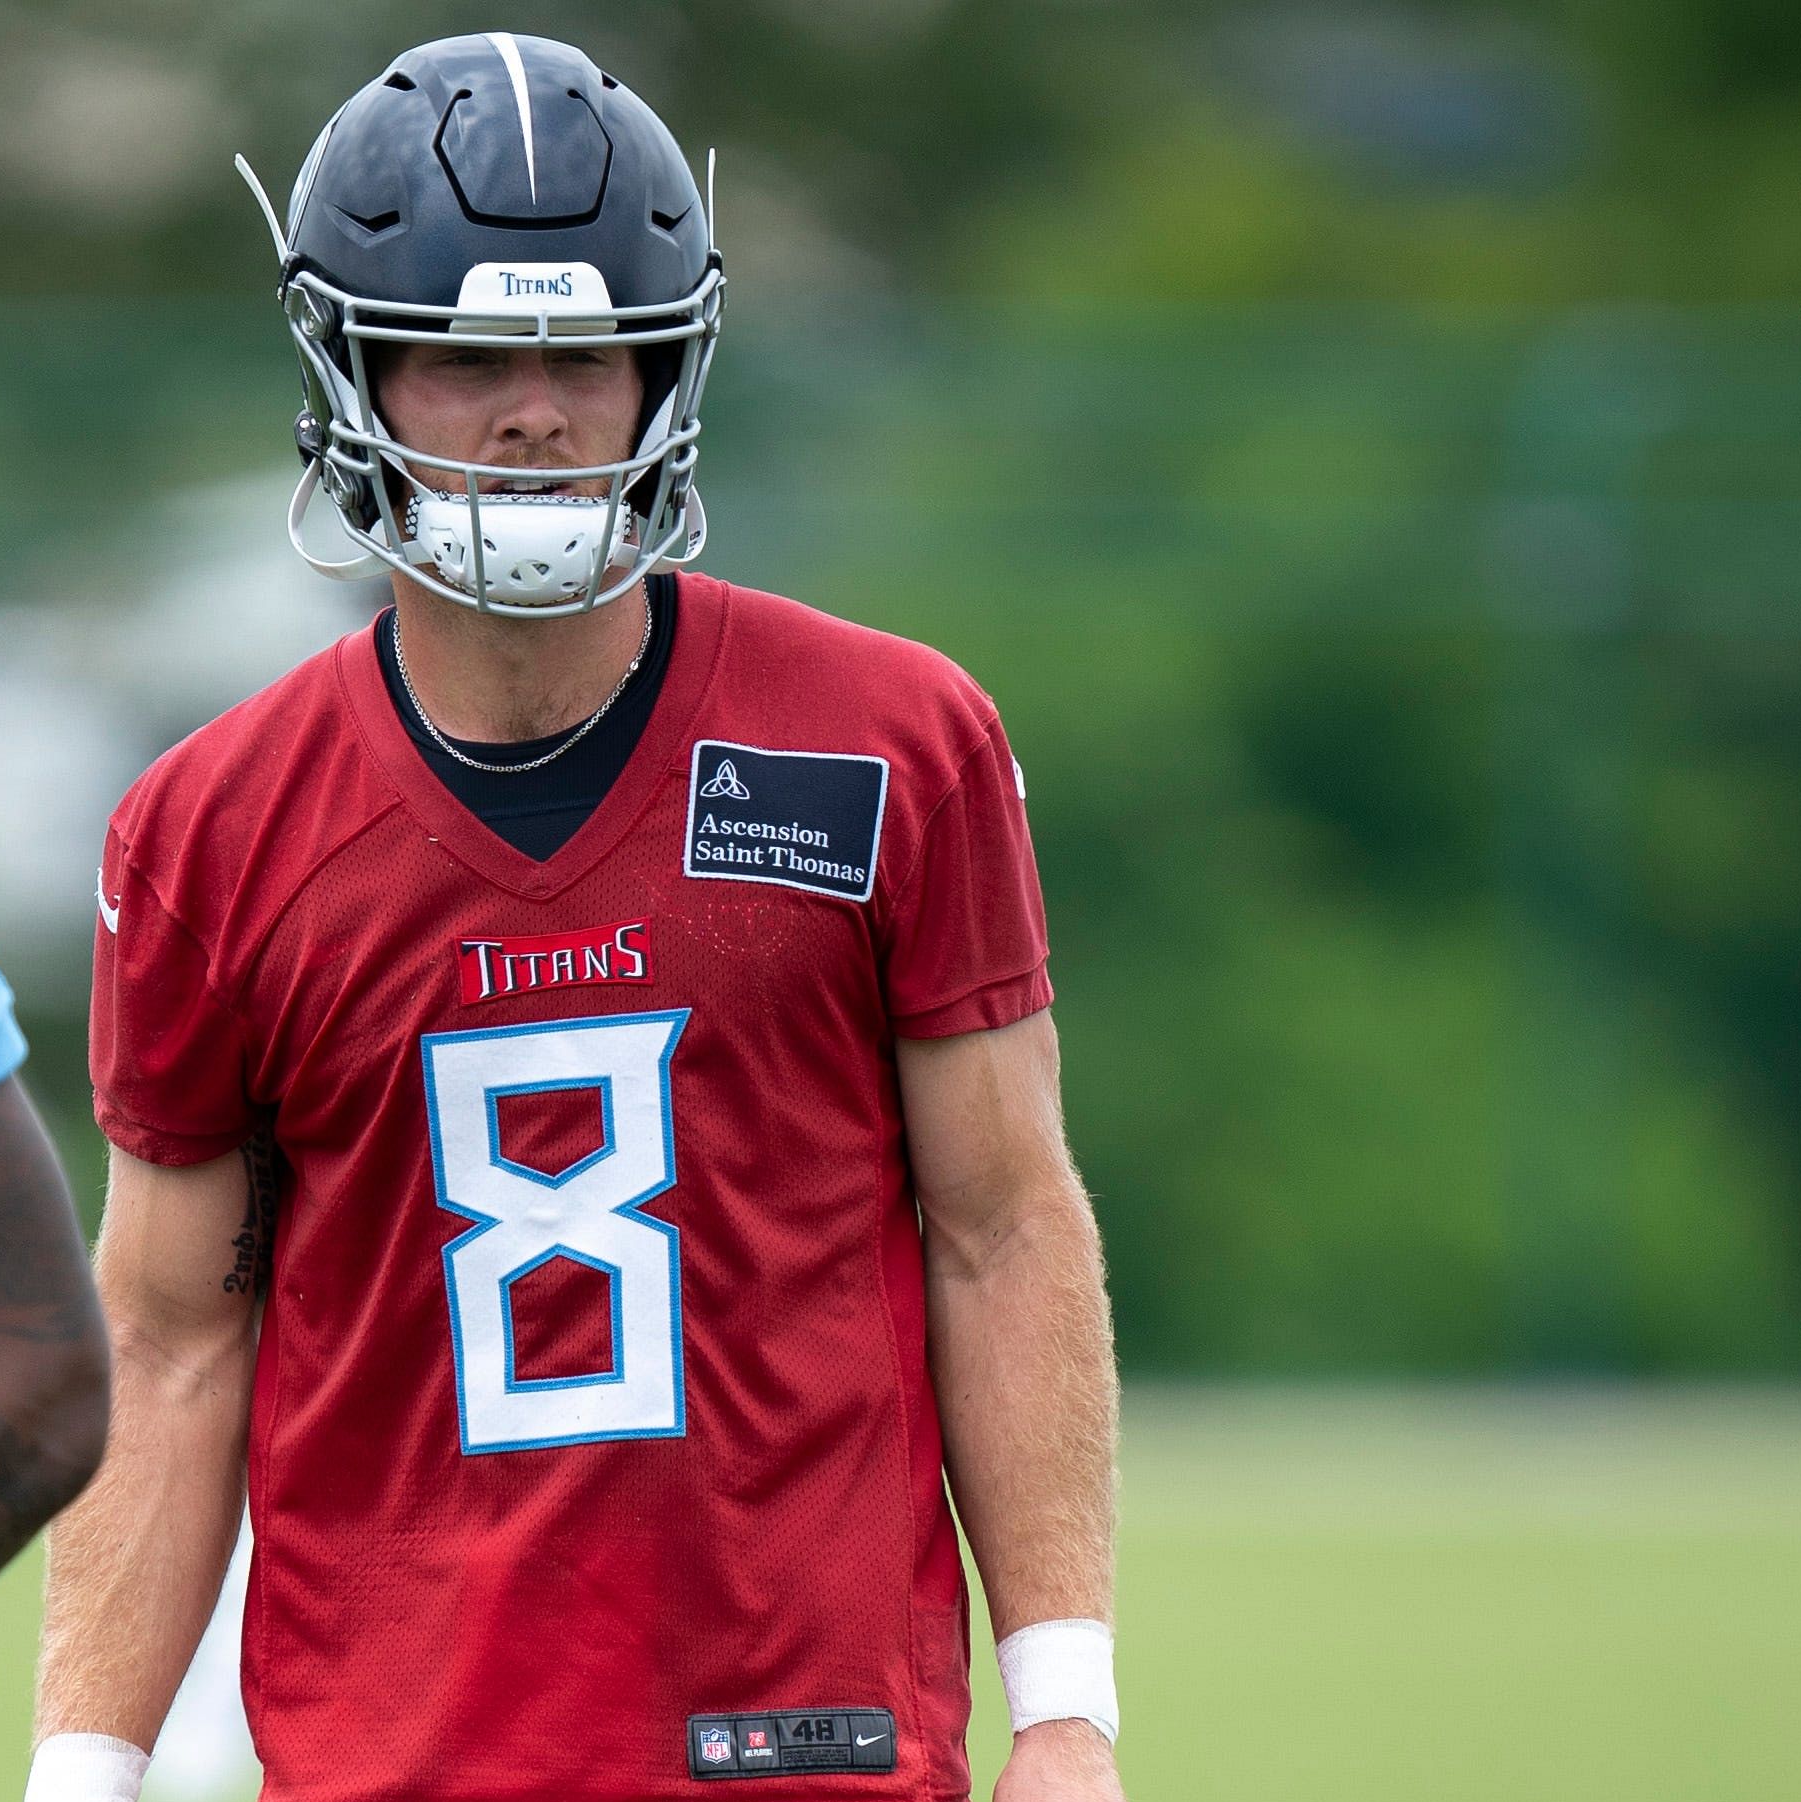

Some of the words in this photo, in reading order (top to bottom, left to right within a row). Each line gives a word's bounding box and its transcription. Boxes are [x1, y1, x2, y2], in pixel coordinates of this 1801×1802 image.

[499, 271, 573, 297] TITANS
[698, 813, 829, 848] Ascension
[695, 840, 765, 866] Saint
[768, 845, 867, 884] Thomas
[462, 923, 648, 998] TITANS
[420, 1007, 693, 1456] 8
[705, 1743, 727, 1759] NFL
